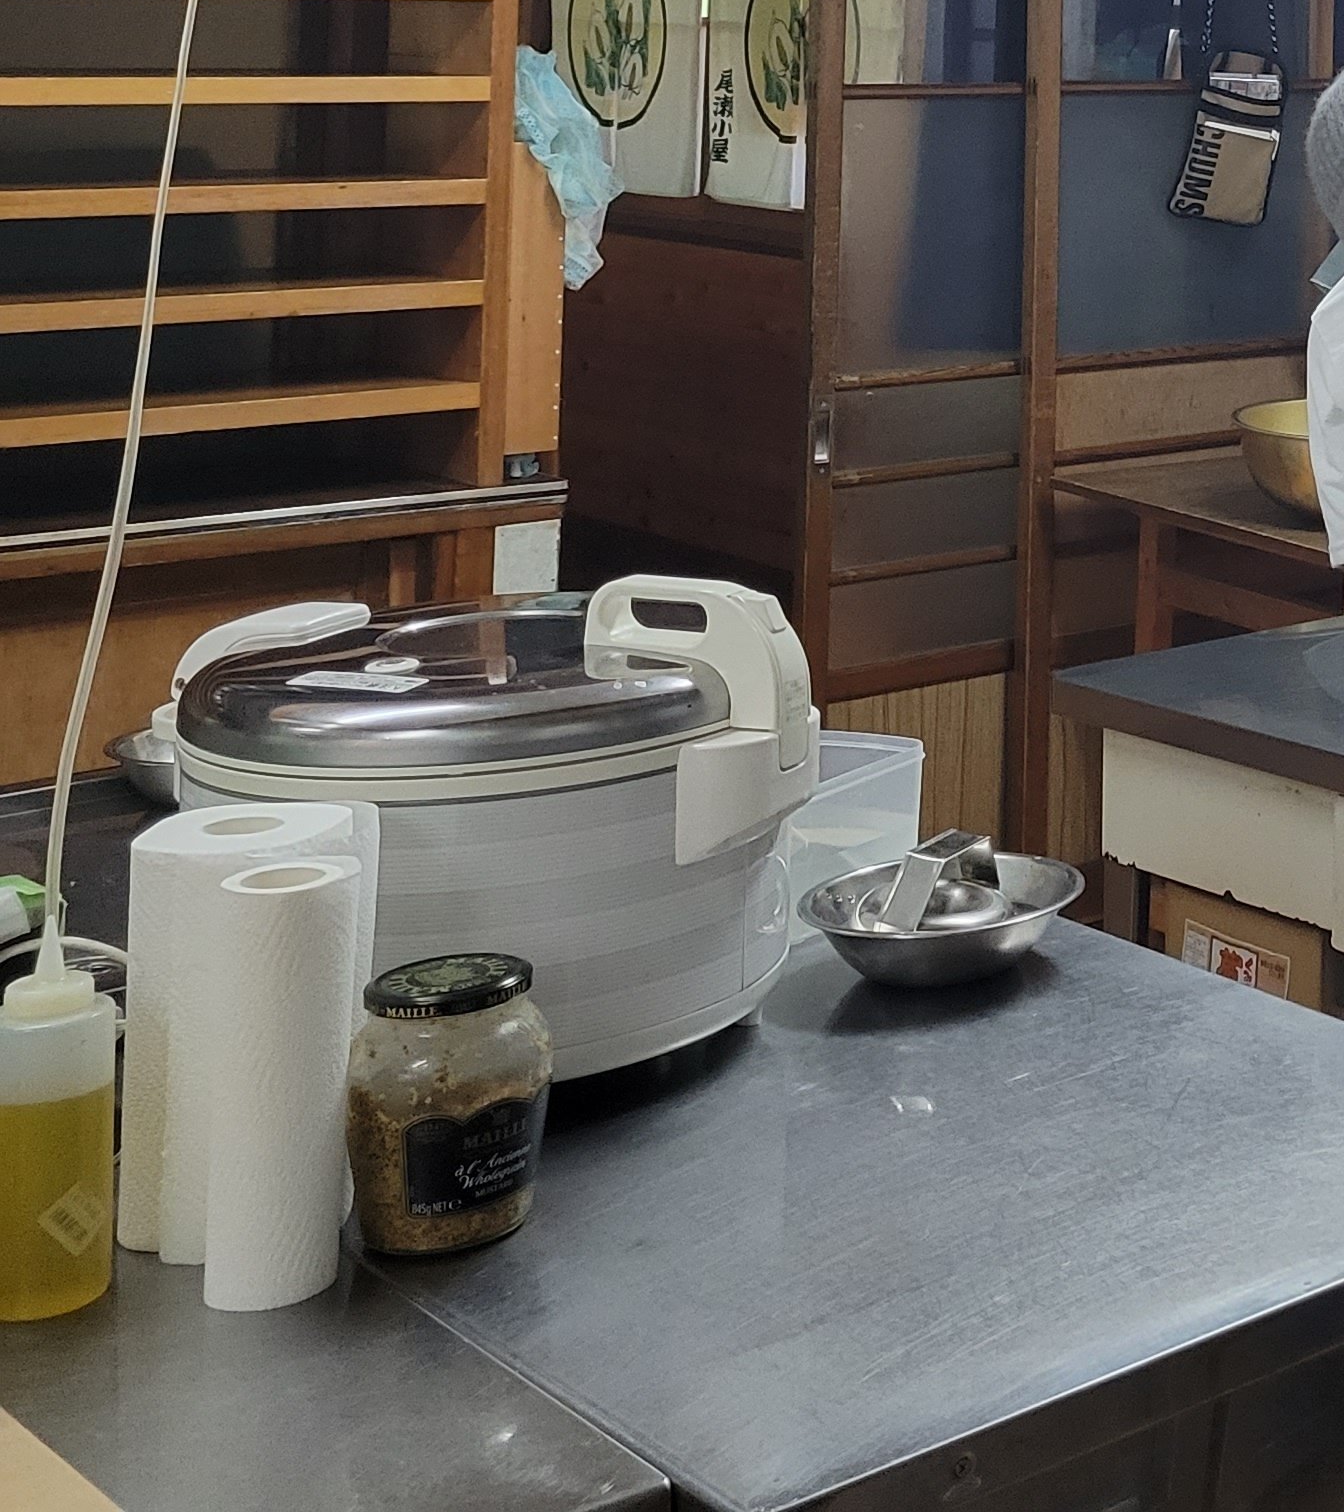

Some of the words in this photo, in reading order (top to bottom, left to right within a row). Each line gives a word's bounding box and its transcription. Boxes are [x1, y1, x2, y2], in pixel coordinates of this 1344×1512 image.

[711, 68, 734, 164] 尾瀬小屋
[1174, 123, 1226, 217] CHUMS
[385, 1005, 439, 1019] MAILLE
[462, 1116, 529, 1151] MAILL
[433, 1200, 447, 1213] NET
